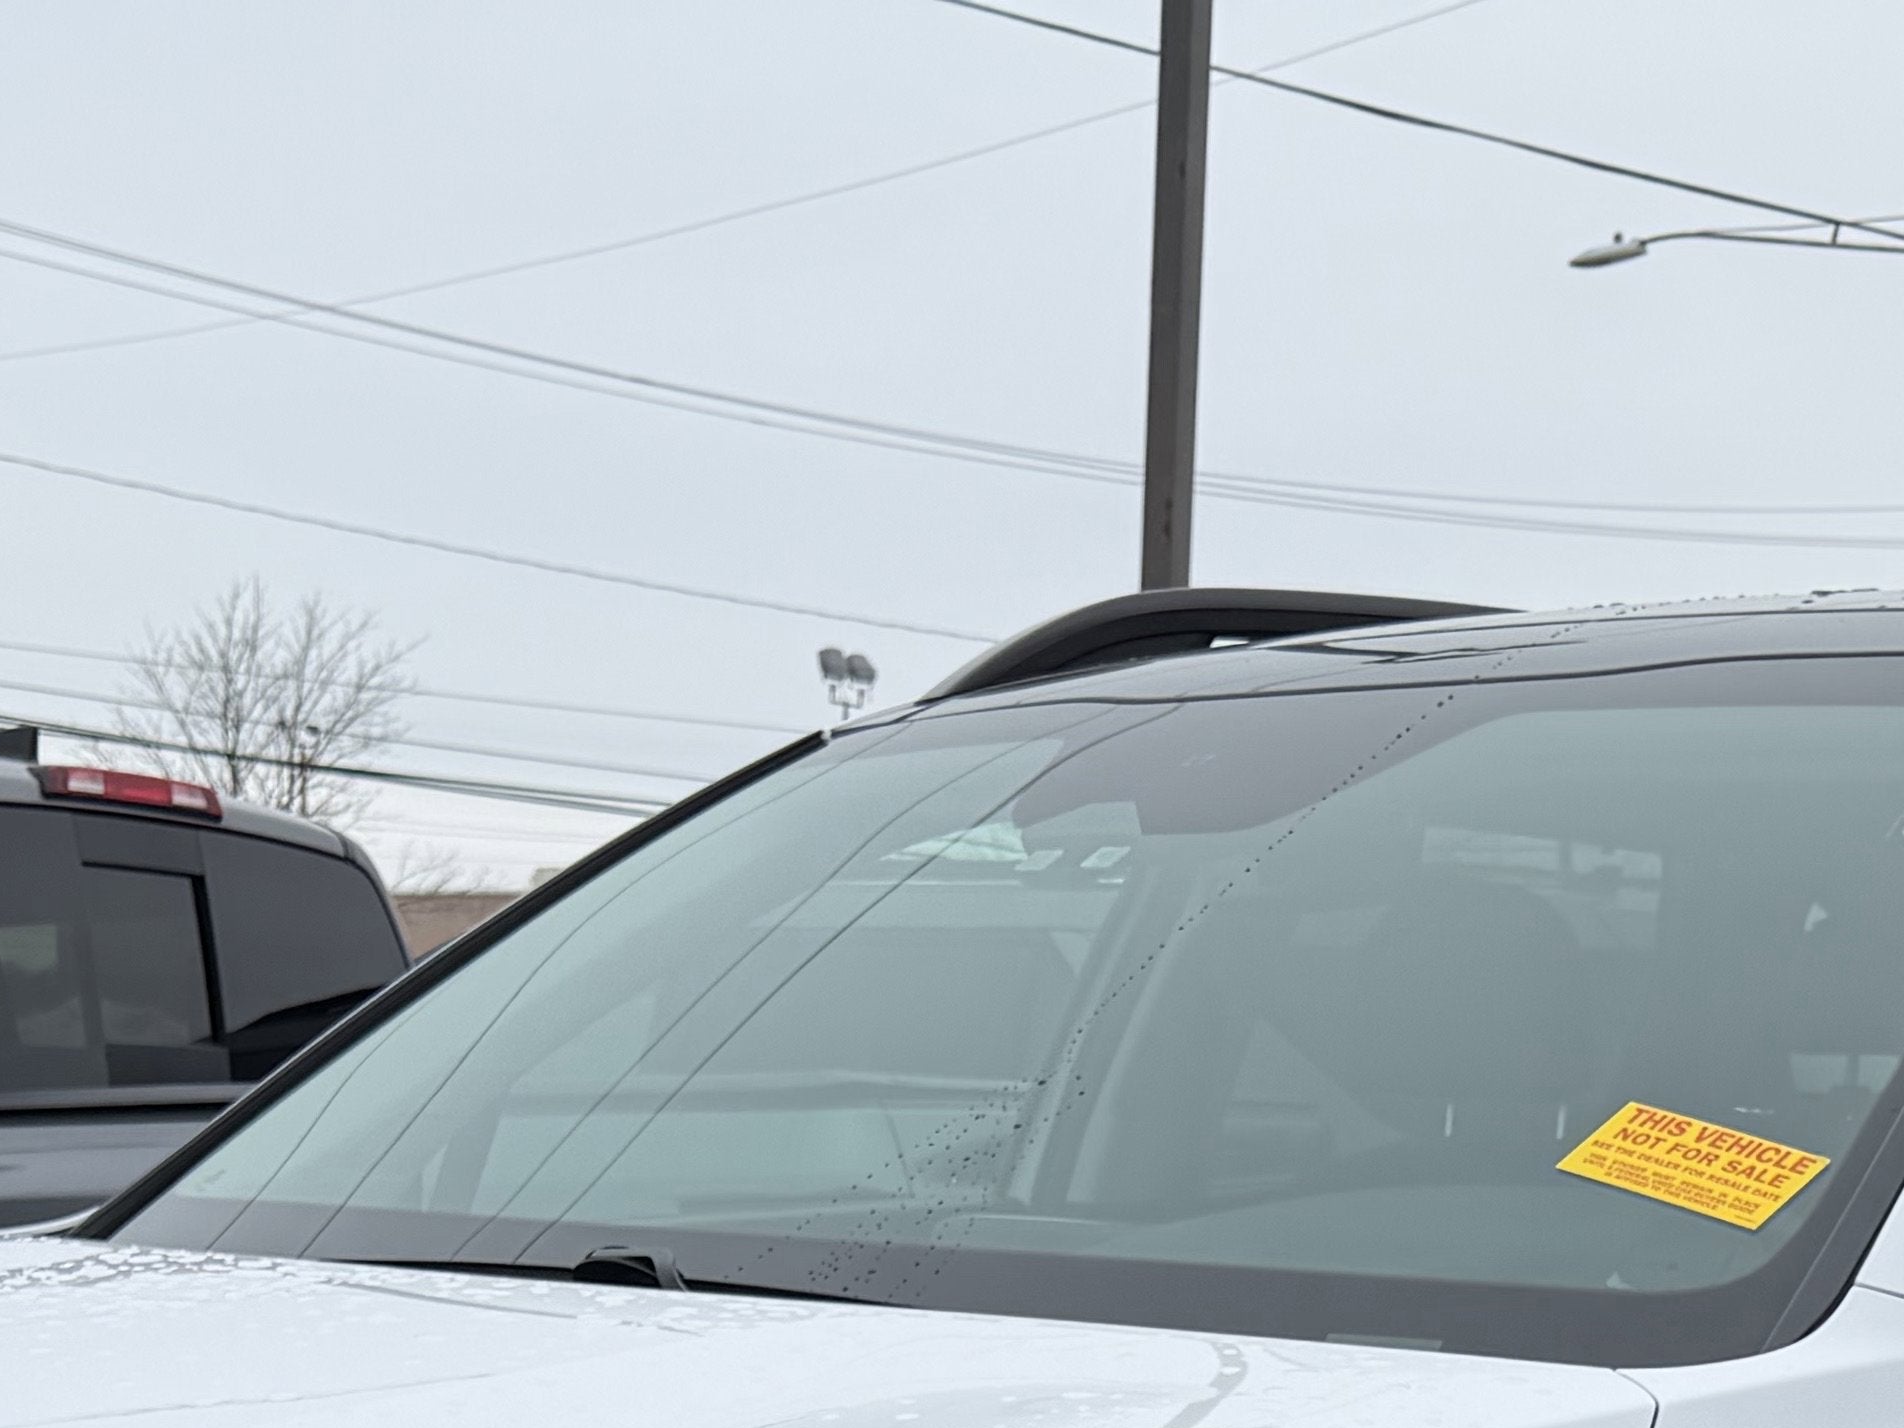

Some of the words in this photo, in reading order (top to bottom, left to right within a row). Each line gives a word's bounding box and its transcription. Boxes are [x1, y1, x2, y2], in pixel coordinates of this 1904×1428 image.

[1613, 1127, 1667, 1151] NOT
[1665, 1142, 1719, 1168] FOR
[1720, 1158, 1792, 1189] SALE
[1625, 1108, 1693, 1138] THIS
[1692, 1127, 1818, 1175] VEHICLE
[1634, 1152, 1681, 1171] DEALER
[1679, 1166, 1707, 1178] FOR
[1704, 1174, 1752, 1192] RESALE
